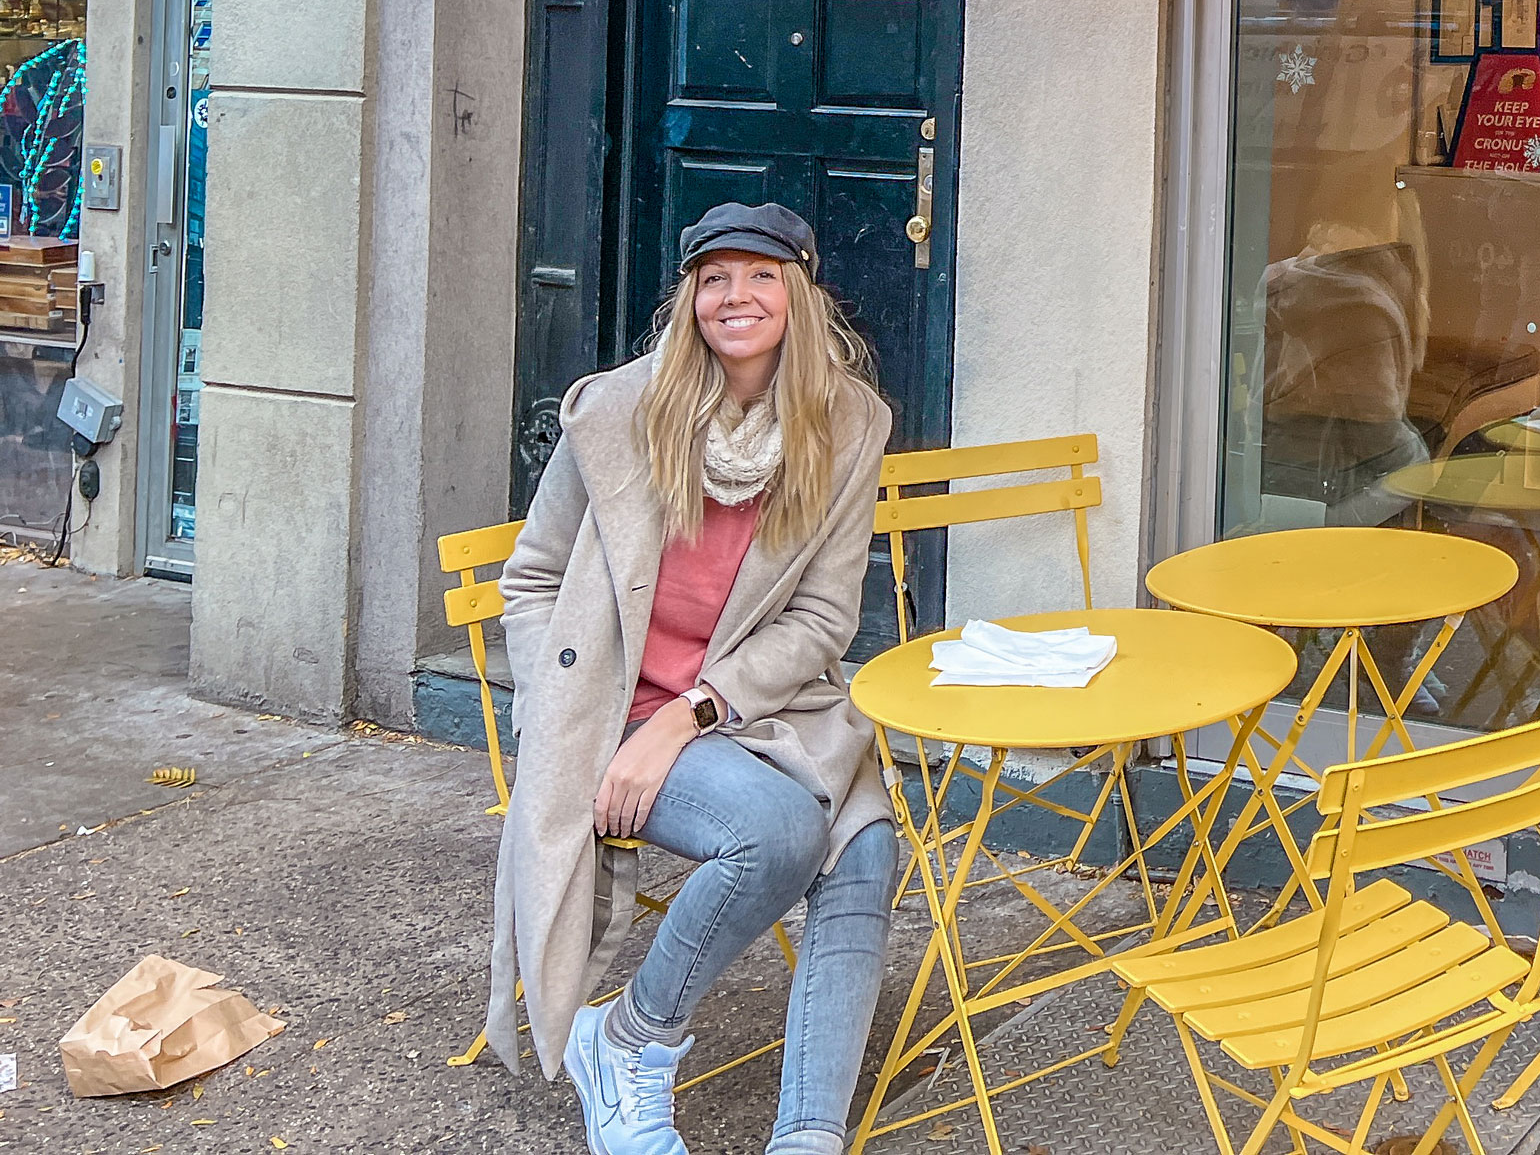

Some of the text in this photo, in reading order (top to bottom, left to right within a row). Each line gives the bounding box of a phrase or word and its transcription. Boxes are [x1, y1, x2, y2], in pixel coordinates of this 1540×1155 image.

[1494, 101, 1529, 114] KEEP
[1477, 113, 1512, 127] YOUR
[1474, 138, 1528, 151] CRONU
